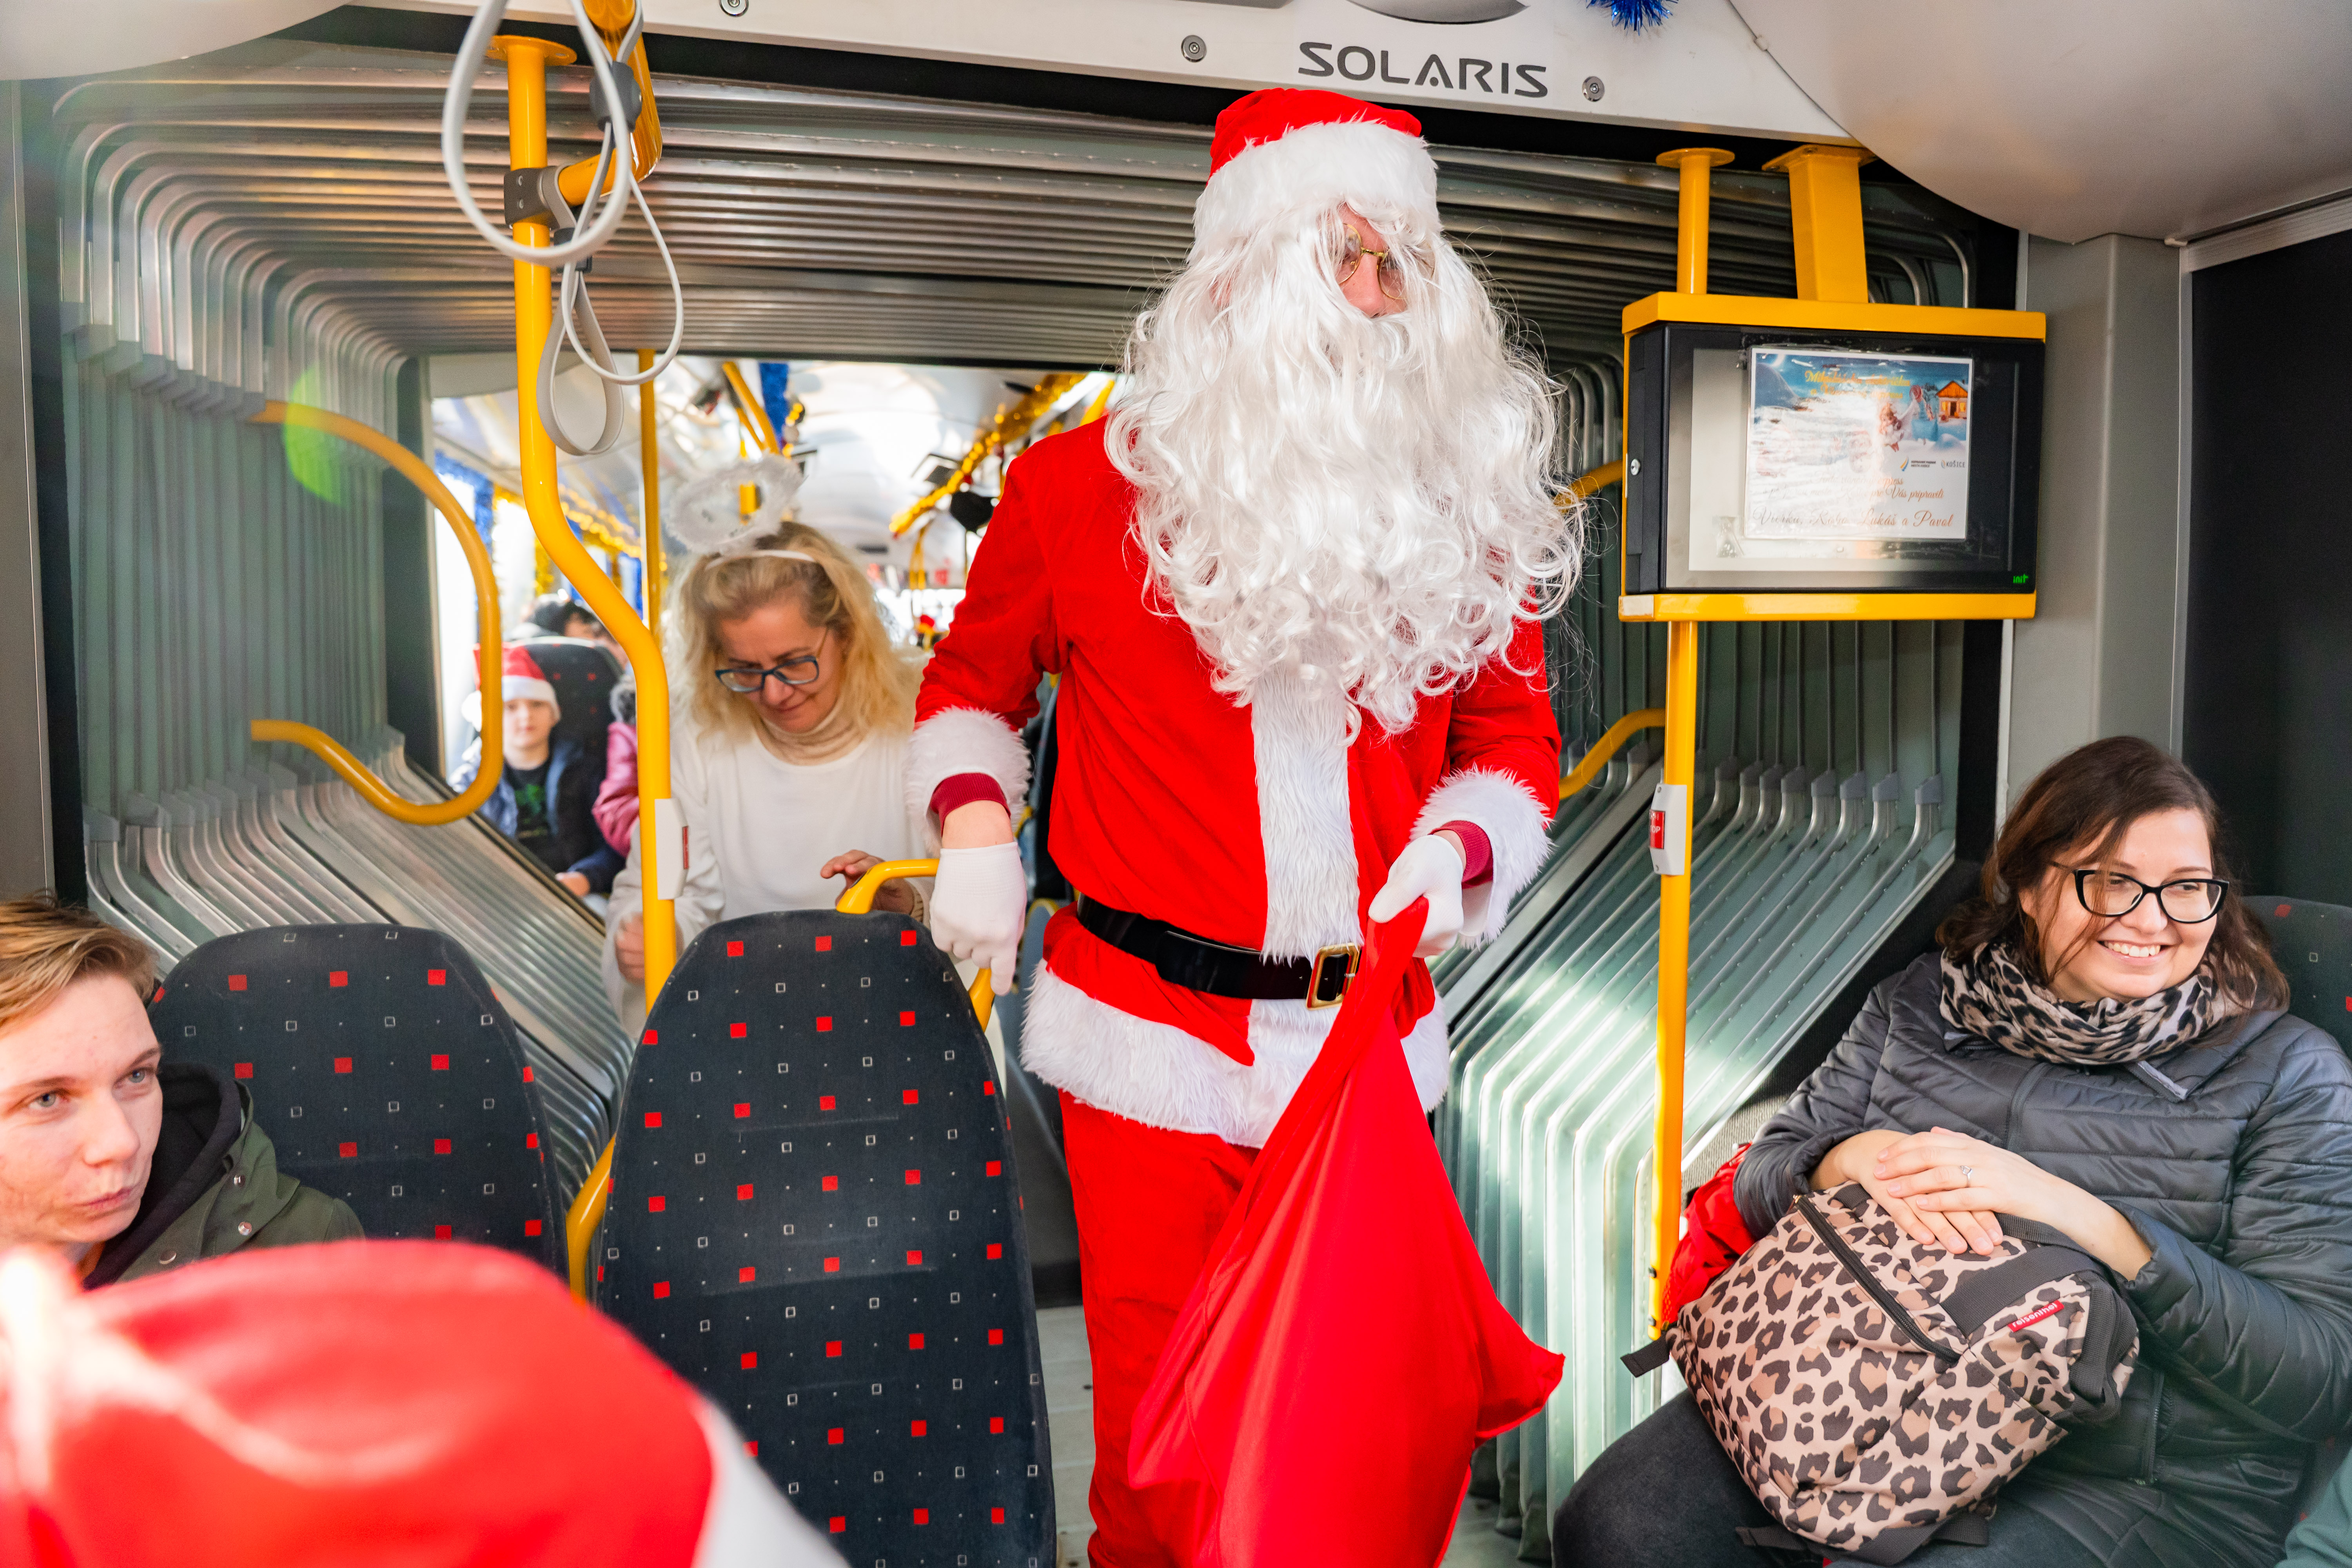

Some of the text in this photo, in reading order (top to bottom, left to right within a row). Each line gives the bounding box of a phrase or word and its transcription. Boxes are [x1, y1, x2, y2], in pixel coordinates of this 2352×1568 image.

[1298, 42, 1548, 98] SOLARIS
[1885, 485, 1907, 499] Vás
[1907, 488, 1944, 502] pripravili
[1857, 508, 1897, 530] Lukáš
[1902, 518, 1909, 526] a
[1913, 510, 1954, 527] Pavol
[2012, 1302, 2058, 1328] reisenthel
